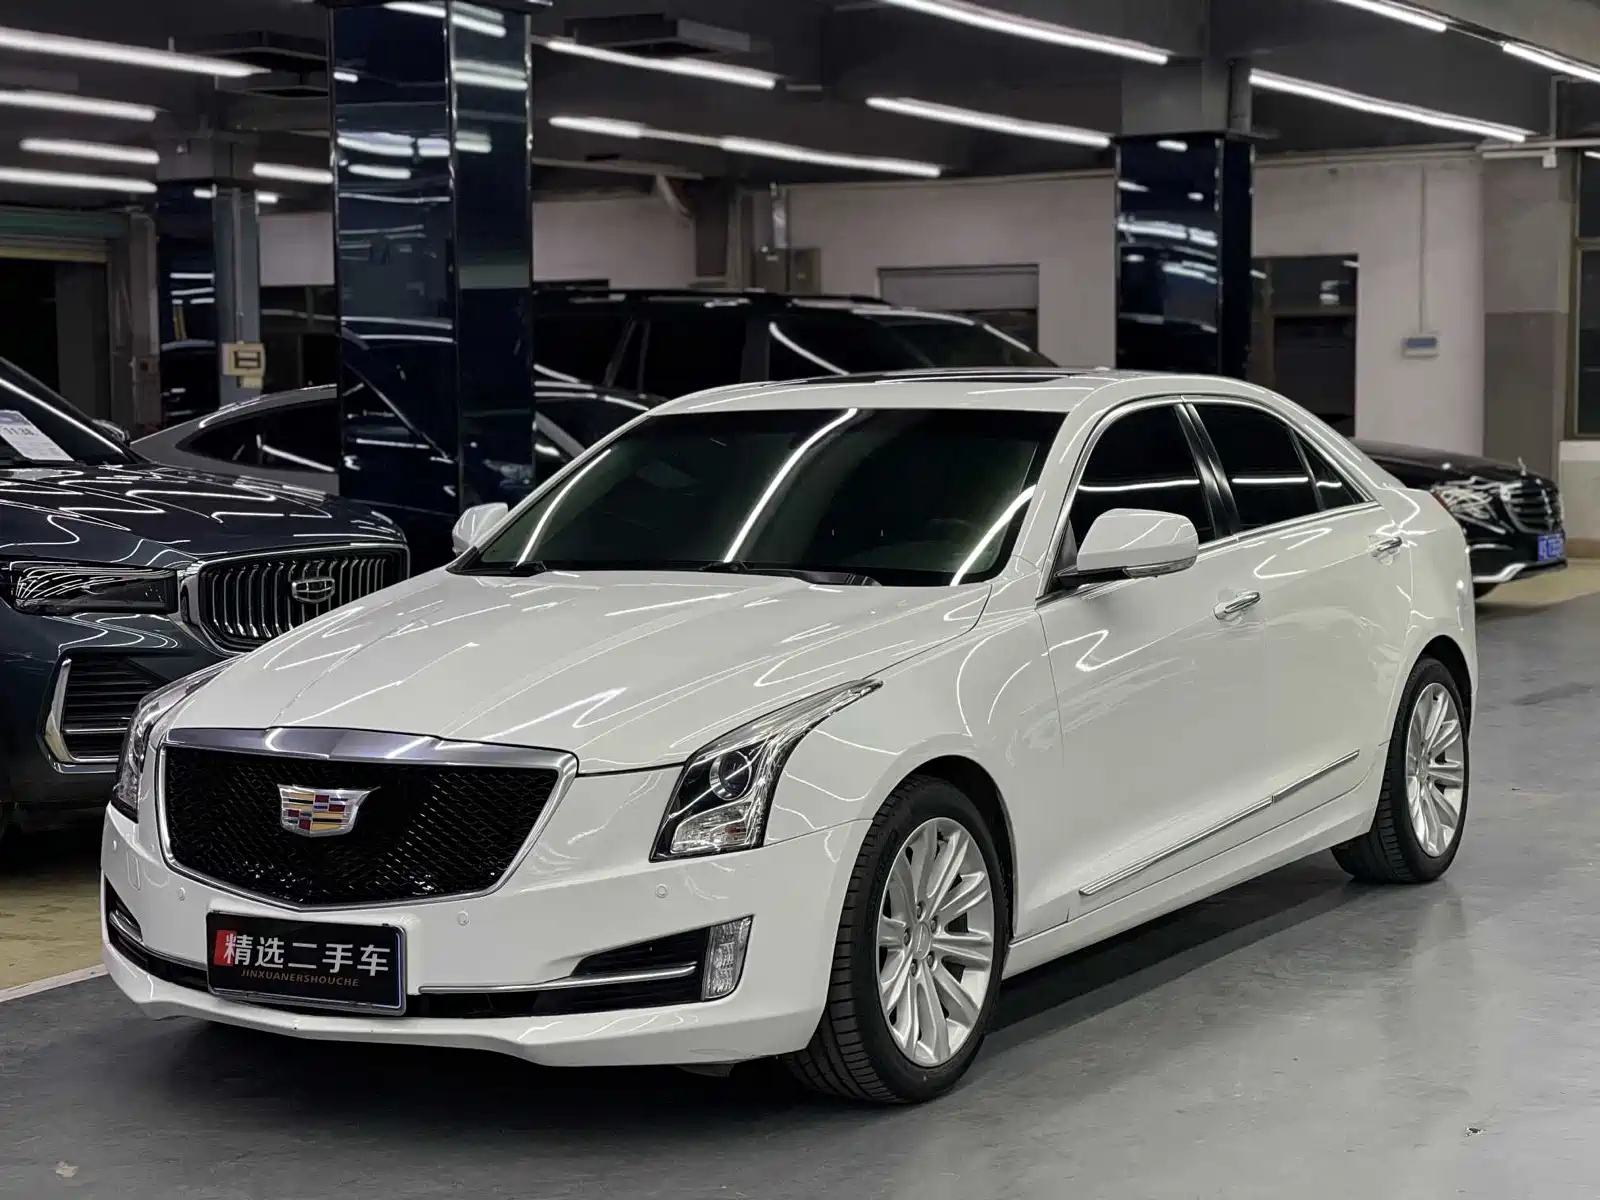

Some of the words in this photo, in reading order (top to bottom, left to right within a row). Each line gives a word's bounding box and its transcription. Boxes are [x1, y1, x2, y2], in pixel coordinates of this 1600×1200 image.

[223, 934, 391, 977] 精选二手车
[241, 968, 360, 987] JINXUANERSHOUCHE
